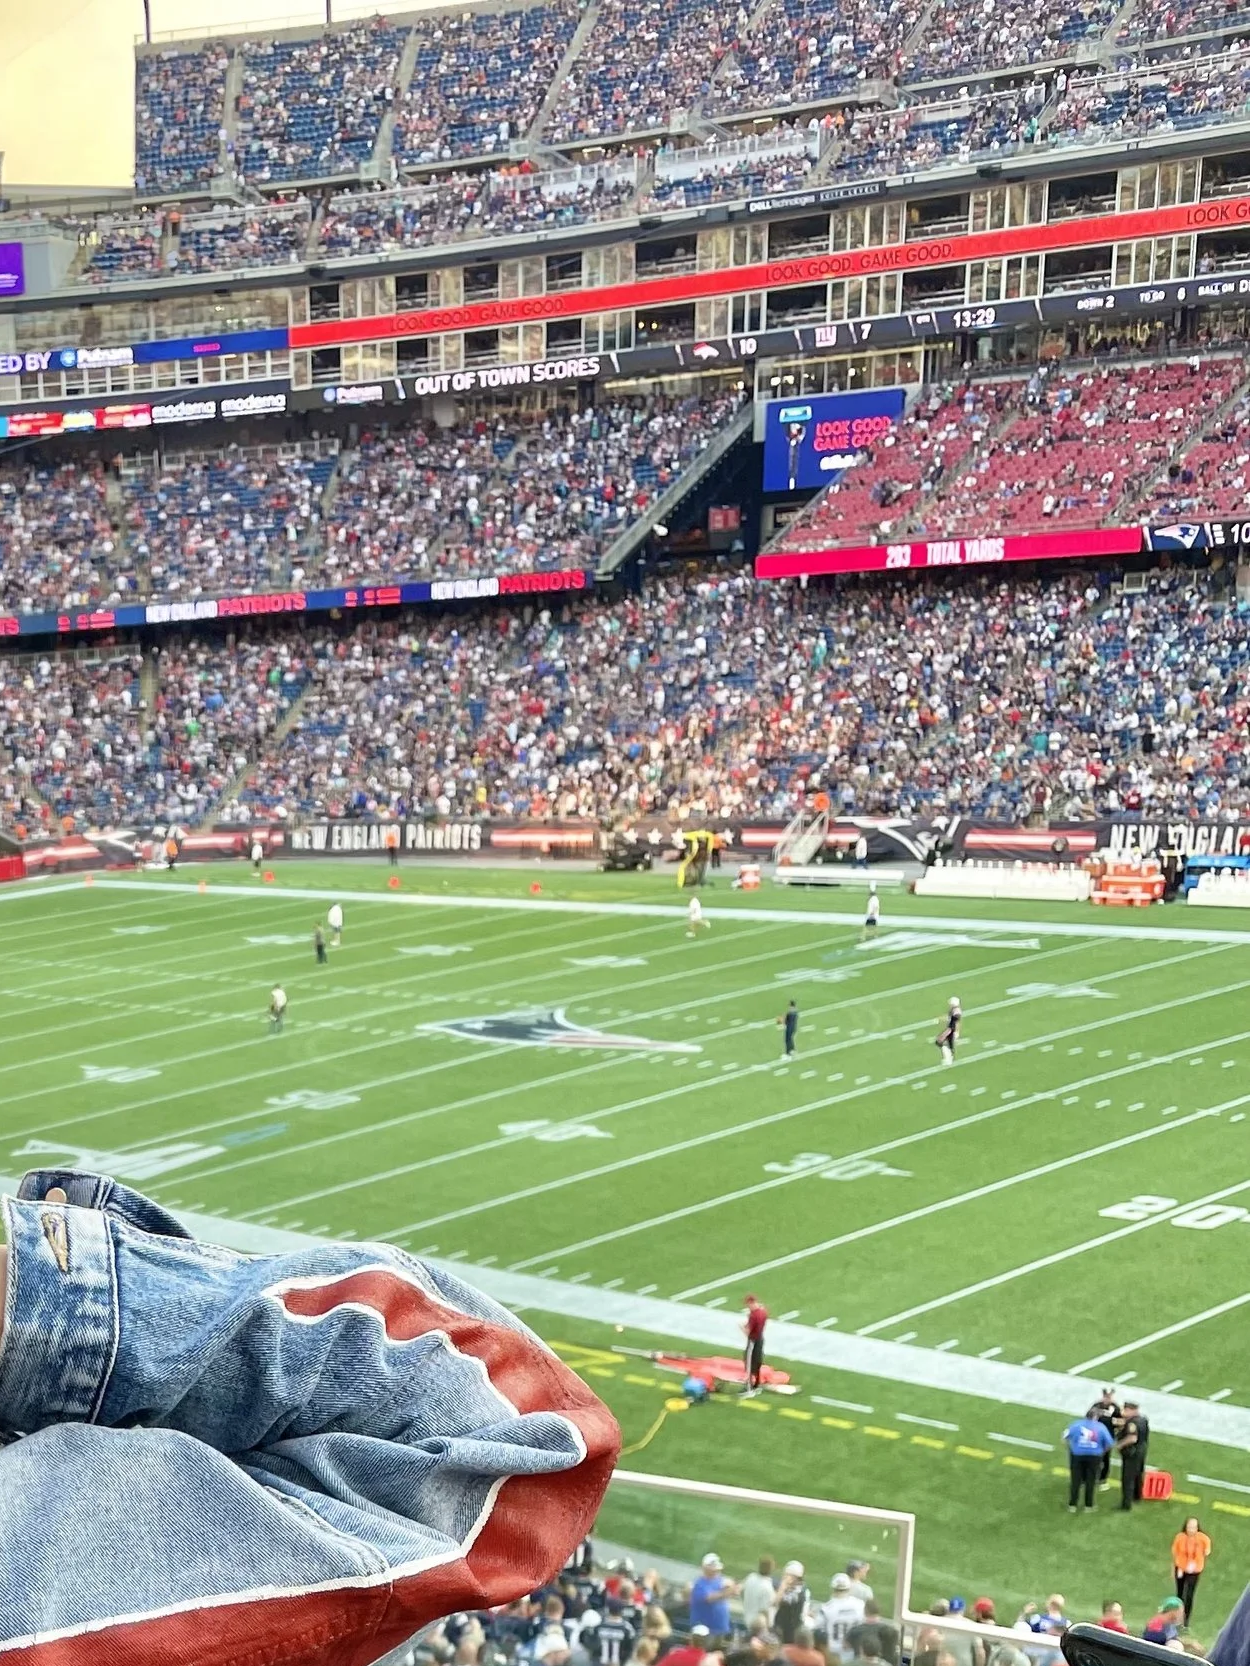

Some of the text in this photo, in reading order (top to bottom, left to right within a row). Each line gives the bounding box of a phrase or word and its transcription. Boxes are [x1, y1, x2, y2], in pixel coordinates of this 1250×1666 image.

[1187, 205, 1231, 225] LOOK
[765, 265, 804, 283] LOOK
[860, 251, 901, 268] GAME
[1105, 295, 1115, 309] 2
[1139, 291, 1151, 303] TO
[1152, 290, 1166, 301] GO
[1198, 284, 1220, 297] BALL
[1221, 282, 1235, 293] ON
[478, 303, 519, 320] GAME
[739, 339, 757, 356] 10
[861, 323, 872, 341] 7
[952, 308, 997, 329] 13:29
[23, 351, 52, 372] BY
[77, 346, 133, 363] Putnam
[414, 376, 451, 396] OUT
[452, 374, 476, 392] OF
[479, 365, 531, 388] TOWN
[532, 357, 601, 383] SCORES
[151, 400, 217, 419] moderna
[221, 393, 287, 413] moderna
[815, 421, 851, 437] LOOK
[813, 434, 851, 452] GAME
[926, 540, 962, 565] TOTAL
[964, 536, 1005, 562] YARDS
[500, 570, 585, 594] PATRIOTS
[218, 591, 306, 616] PATRIOTS
[291, 825, 327, 850] NEW
[405, 823, 482, 850] PATRIOTS
[1109, 824, 1160, 857] NEW
[1097, 1194, 1249, 1230] 20
[1147, 1477, 1167, 1498] 10
